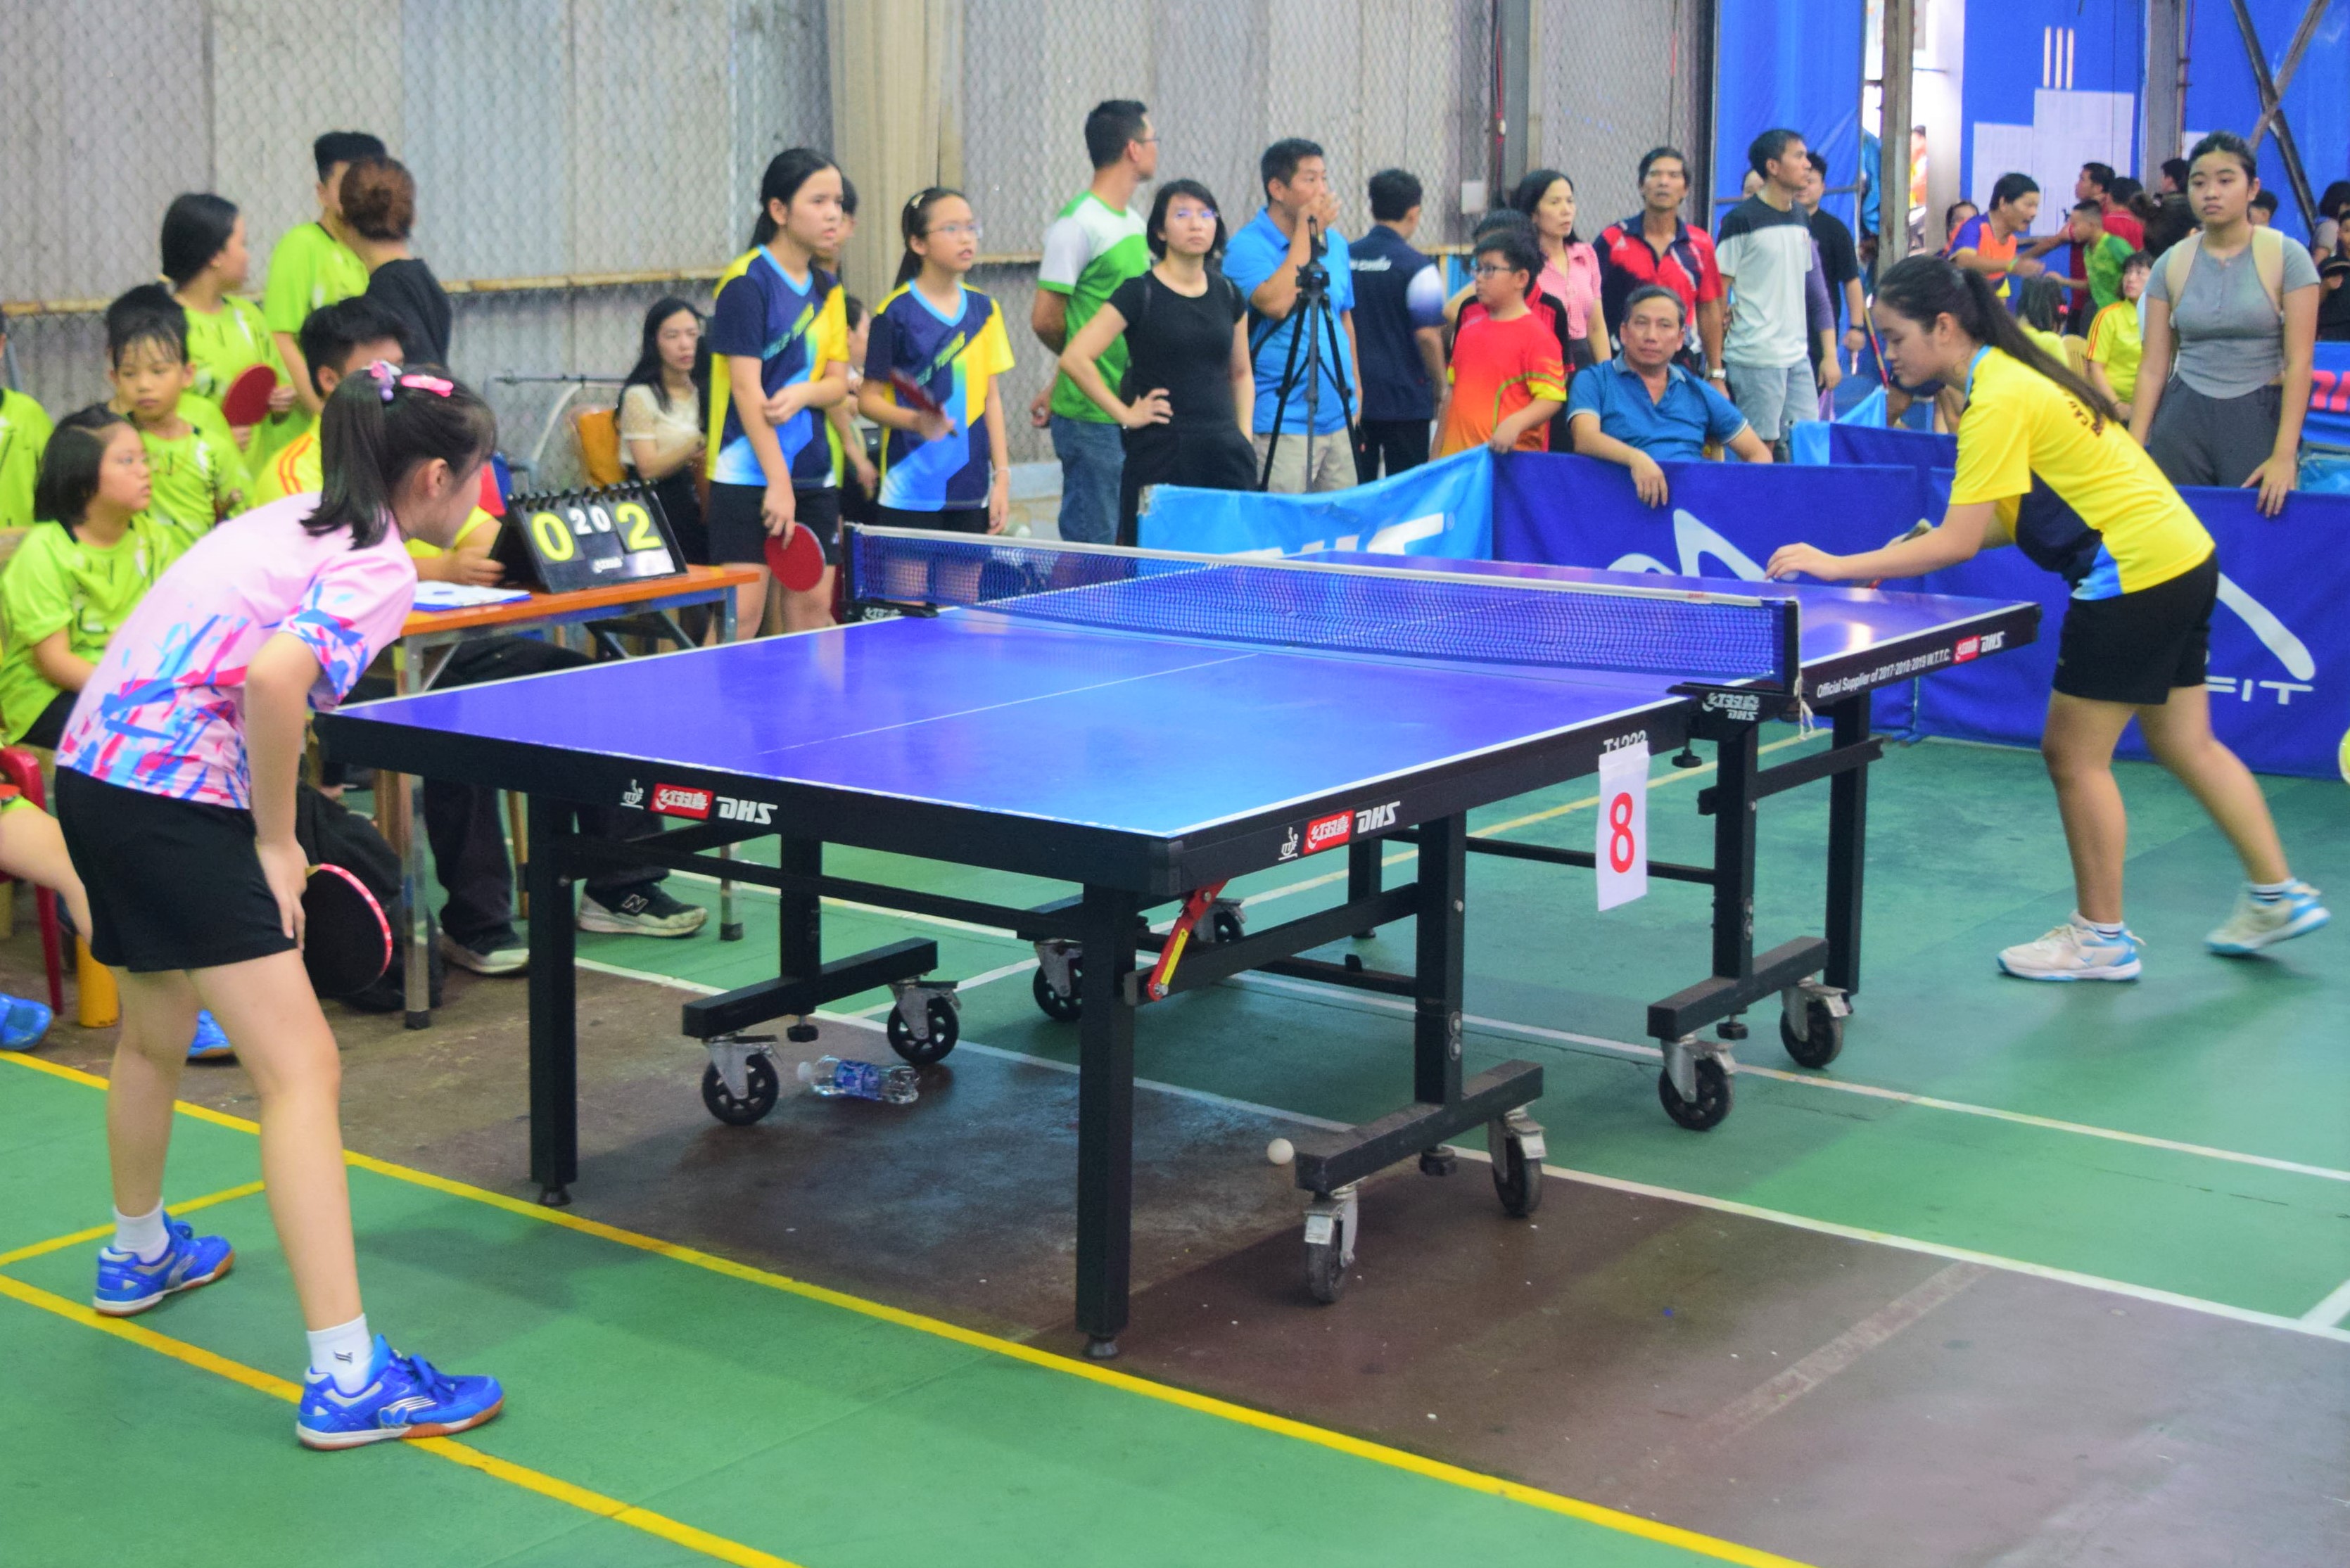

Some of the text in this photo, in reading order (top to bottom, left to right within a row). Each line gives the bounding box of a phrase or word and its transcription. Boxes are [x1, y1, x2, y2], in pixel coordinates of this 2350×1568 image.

[531, 511, 575, 561] 0
[615, 502, 662, 550] 2
[1817, 678, 1841, 698] Official
[1842, 672, 1870, 692] Supplier
[1871, 668, 1879, 682] of
[1727, 709, 1758, 721] DHS
[716, 796, 778, 825] DHS
[1355, 801, 1401, 834] DHS
[1609, 792, 1635, 874] 8
